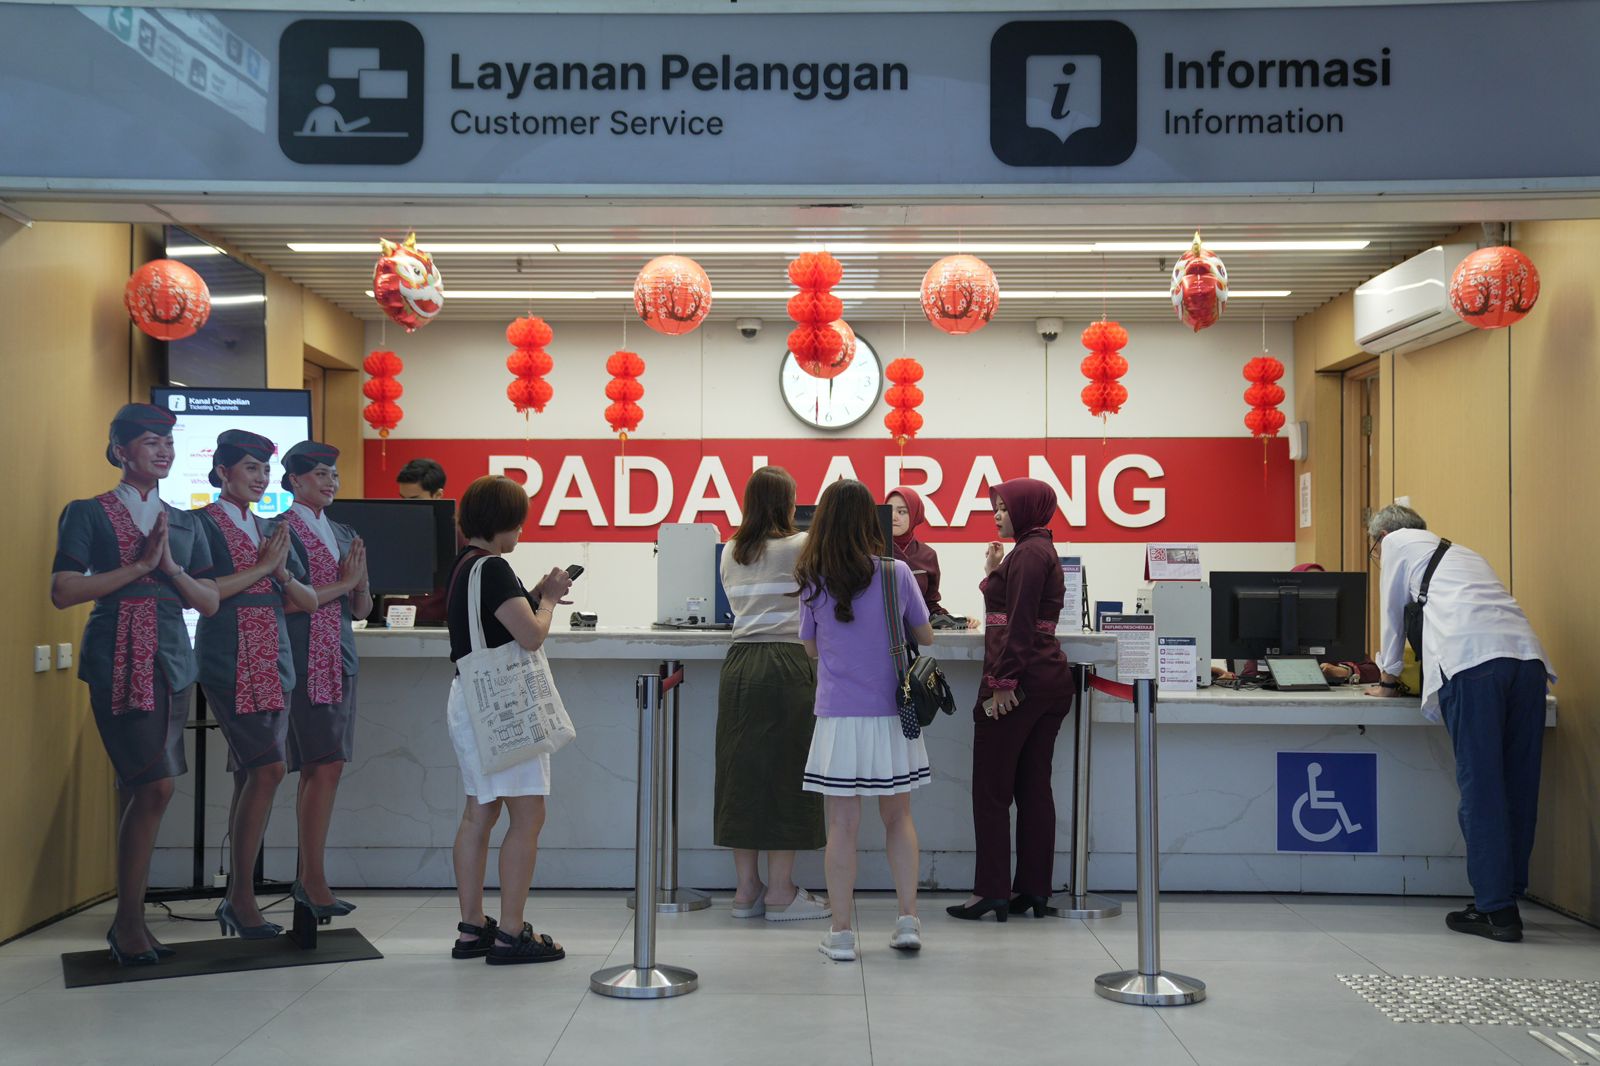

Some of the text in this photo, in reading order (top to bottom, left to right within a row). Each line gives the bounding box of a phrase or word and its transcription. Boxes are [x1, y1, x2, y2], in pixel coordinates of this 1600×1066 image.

[451, 53, 909, 101] Layanan Pelanggan
[1164, 47, 1391, 89] Informasi
[450, 109, 723, 135] Customer Service
[1165, 108, 1344, 134] Information
[188, 397, 251, 406] Kanal Pembelian
[825, 412, 833, 422] 6
[488, 453, 1166, 528] PADARANG
